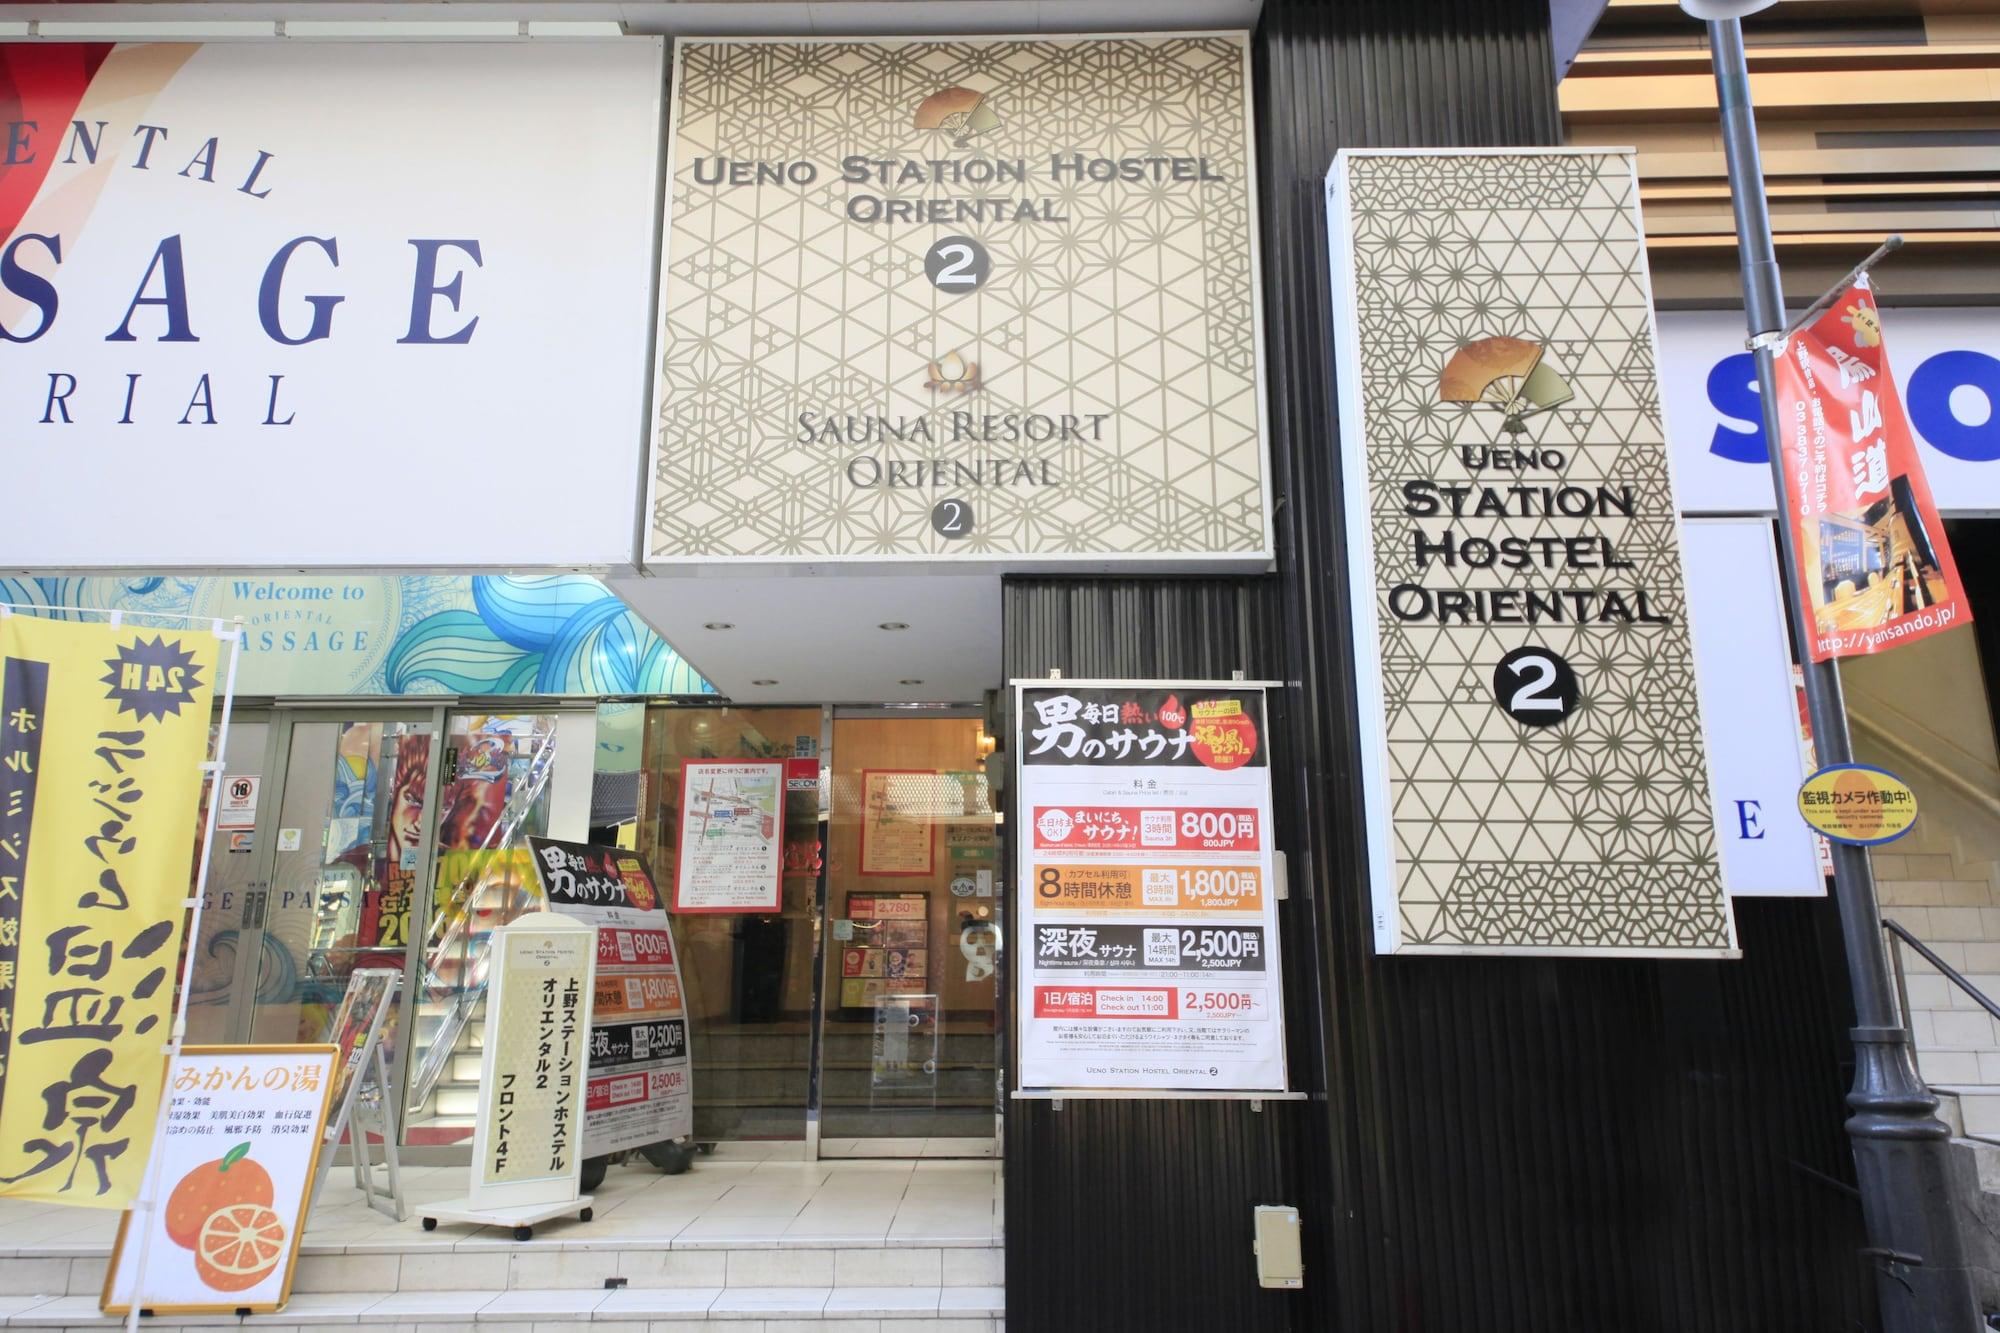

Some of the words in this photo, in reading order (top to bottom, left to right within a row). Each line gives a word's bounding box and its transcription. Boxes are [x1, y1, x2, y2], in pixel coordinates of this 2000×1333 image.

[2, 120, 275, 200] ENTAL
[693, 156, 818, 187] UENO
[841, 154, 1026, 186] STATION
[1050, 153, 1224, 184] HOSTEL
[846, 194, 1070, 225] ORIENTAL
[935, 244, 978, 285] 2
[40, 373, 297, 426] RIAL
[796, 411, 935, 445] SAUNA
[950, 411, 1109, 442] RESORT
[846, 456, 1061, 488] ORIENTAL
[1461, 446, 1565, 472] UENO
[1403, 481, 1634, 519] STATION
[1413, 532, 1633, 570] HOSTEL
[233, 581, 333, 600] Welcome
[343, 584, 365, 600] to
[1387, 583, 1670, 625] ORIENTAL
[252, 610, 335, 625] ORIENTAL
[222, 631, 369, 651] ASSAGE
[1510, 655, 1565, 712] 2
[1802, 790, 1911, 805] 監視カメラ作動中!
[1145, 824, 1172, 834] 3時間
[1734, 800, 1765, 839] E
[1203, 839, 1235, 848] 800JPY
[1146, 884, 1173, 895] 8時間
[1150, 873, 1170, 883] 最大
[1200, 898, 1239, 907] 1,800JPY
[1148, 945, 1176, 956] 14時間
[1151, 932, 1171, 943] 最大
[1202, 959, 1241, 968] 2,500JPY
[1101, 994, 1124, 1002] Check
[1126, 994, 1134, 1002] in
[1142, 994, 1164, 1002] 14:00
[1101, 1004, 1124, 1012] Check
[1127, 1004, 1139, 1012] out
[1142, 1004, 1164, 1012] 11:00
[536, 978, 557, 1089] オリエンタル2
[174, 1064, 322, 1092] みかんの湯
[550, 978, 579, 1172] 上野ステーションホステル
[1087, 1067, 1107, 1075] UENO
[1110, 1067, 1139, 1075] STATION
[1173, 1068, 1208, 1076] ORIENTAL
[496, 1074, 516, 1173] フロント4F
